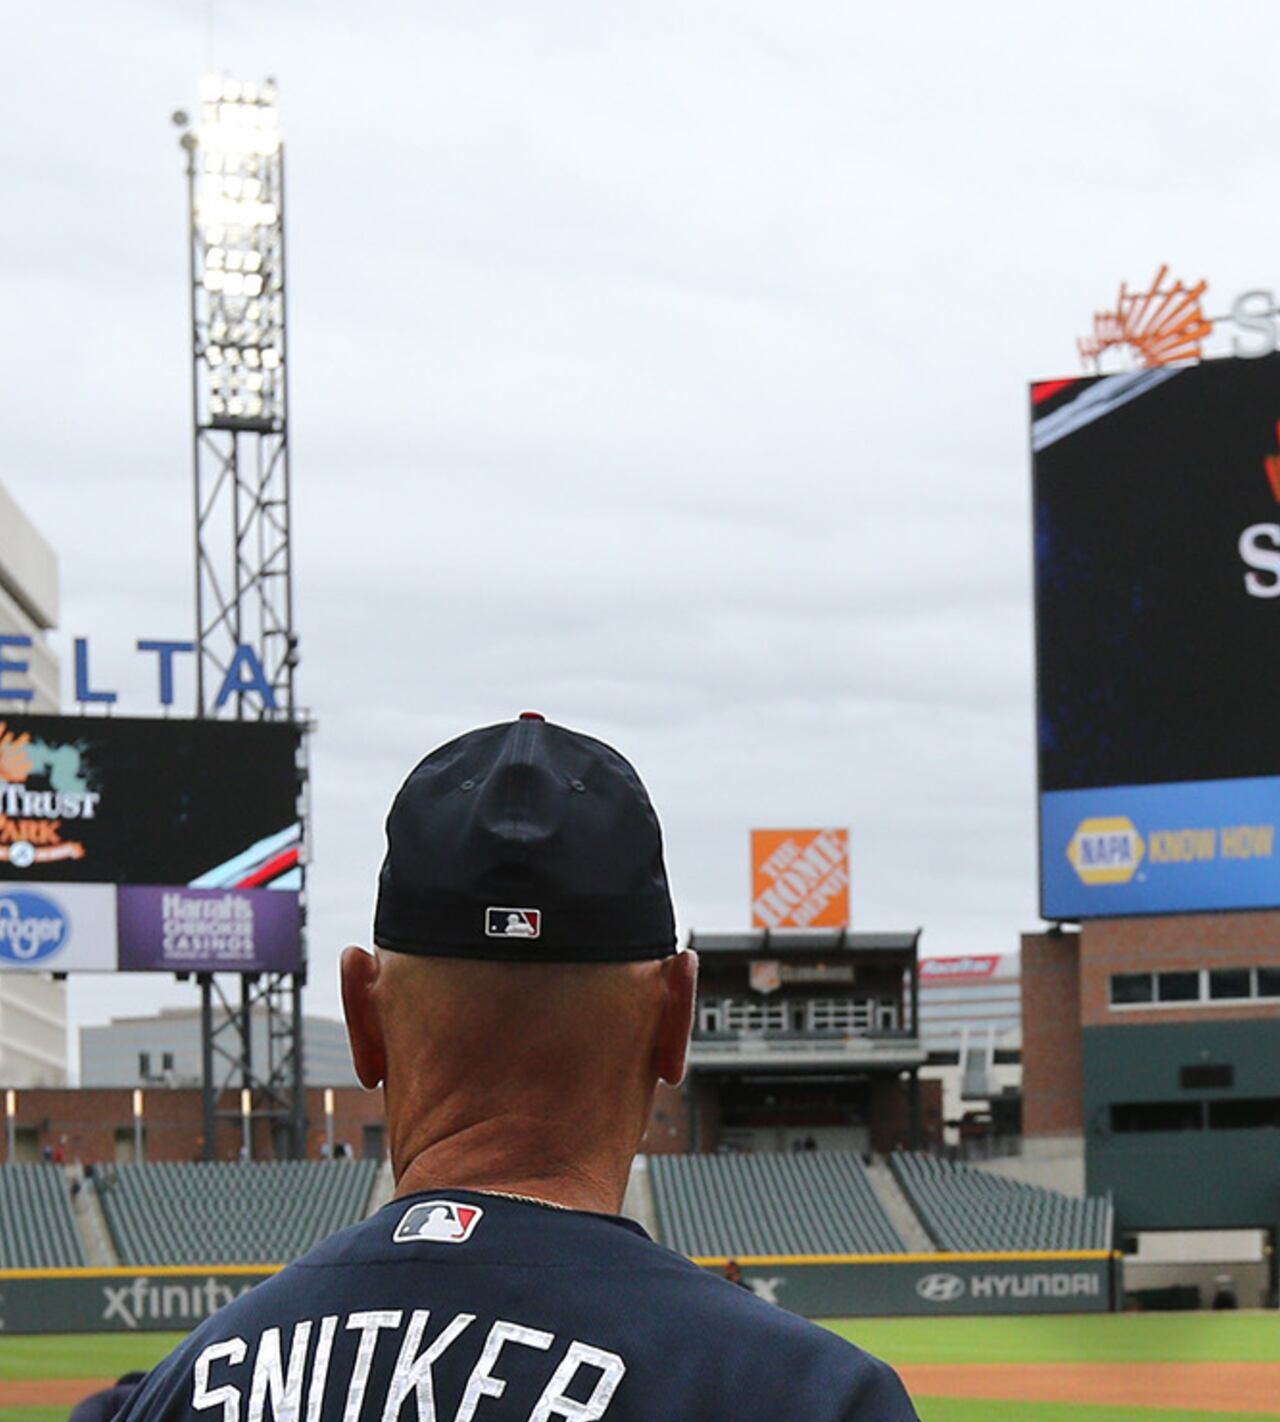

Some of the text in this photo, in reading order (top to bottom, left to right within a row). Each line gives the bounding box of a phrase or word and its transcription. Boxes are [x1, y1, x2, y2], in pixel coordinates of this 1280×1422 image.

[760, 837, 803, 878] THE
[1080, 835, 1134, 867] NAPA
[754, 829, 850, 928] HOME
[971, 1273, 1100, 1299] HYUNDAI
